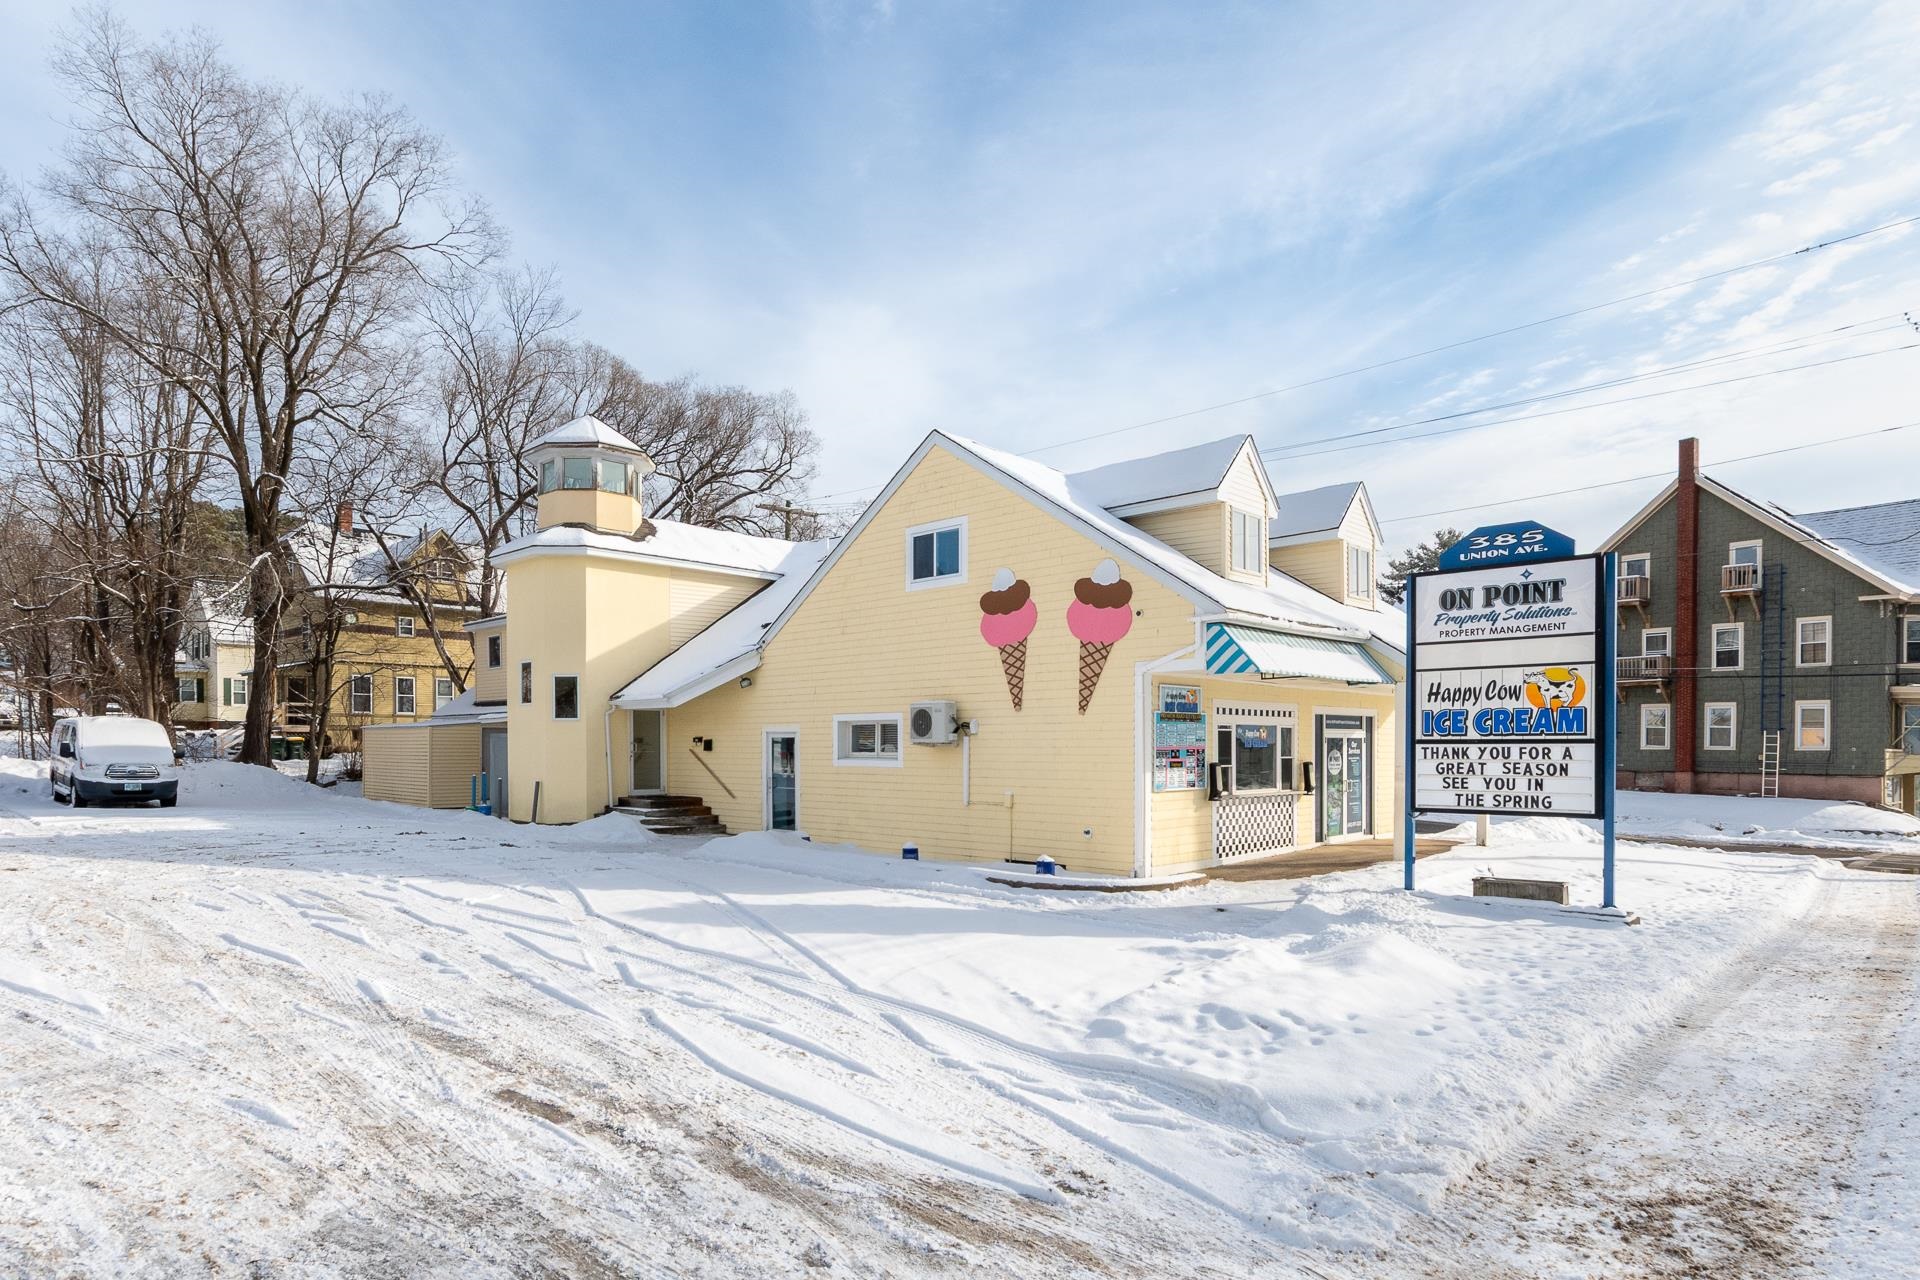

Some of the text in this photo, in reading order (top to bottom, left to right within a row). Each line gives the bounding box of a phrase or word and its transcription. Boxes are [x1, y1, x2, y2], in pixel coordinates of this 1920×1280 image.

[1469, 529, 1544, 549] 385
[1460, 543, 1549, 561] UNION AVE.
[1439, 578, 1567, 612] ON POINT
[1433, 605, 1573, 629] Property Solutions
[1440, 621, 1567, 638] PROPERTY MANAGEMENT
[1427, 679, 1522, 707] Happy Cow
[1422, 706, 1587, 737] ICE CREAM
[1421, 746, 1573, 760] THANK YOU FOR A
[1436, 762, 1569, 777] GREAT SEASON
[1442, 777, 1544, 791] SEE YOU IN
[1455, 793, 1552, 809] THE SPRING
